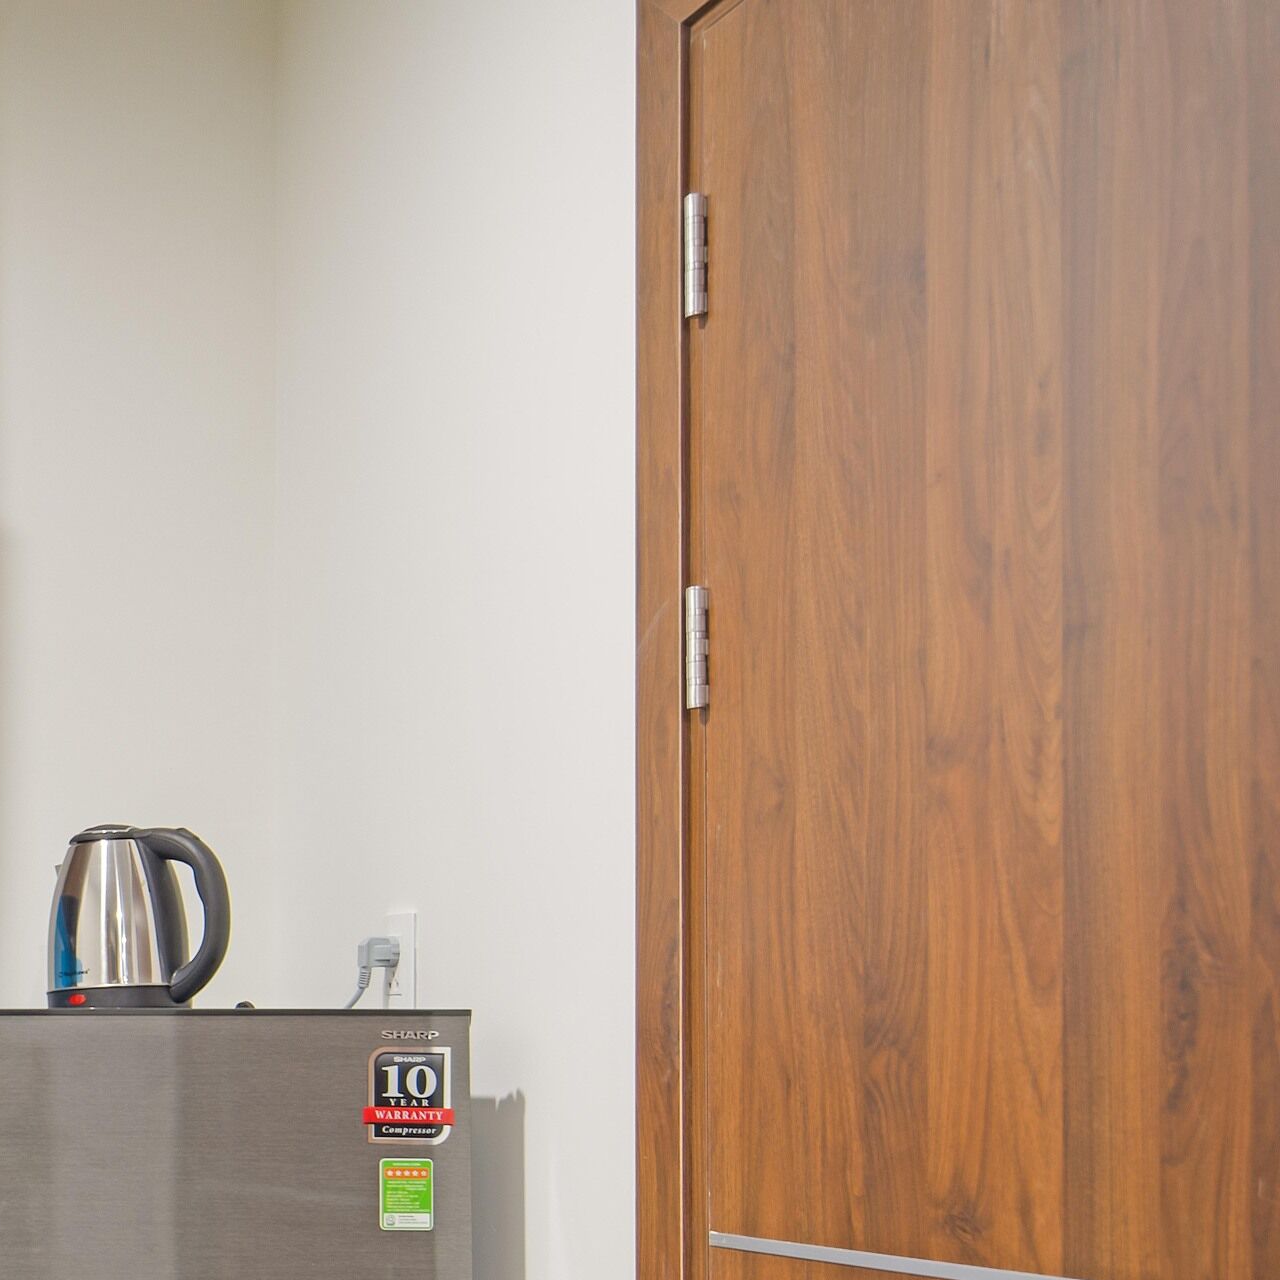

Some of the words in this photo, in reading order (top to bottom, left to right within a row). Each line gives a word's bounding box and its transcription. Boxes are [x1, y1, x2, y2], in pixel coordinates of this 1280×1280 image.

[381, 1030, 440, 1040] SHARP
[381, 1065, 437, 1098] 10
[375, 1109, 443, 1121] WARRANTY
[382, 1125, 437, 1135] Compressor
